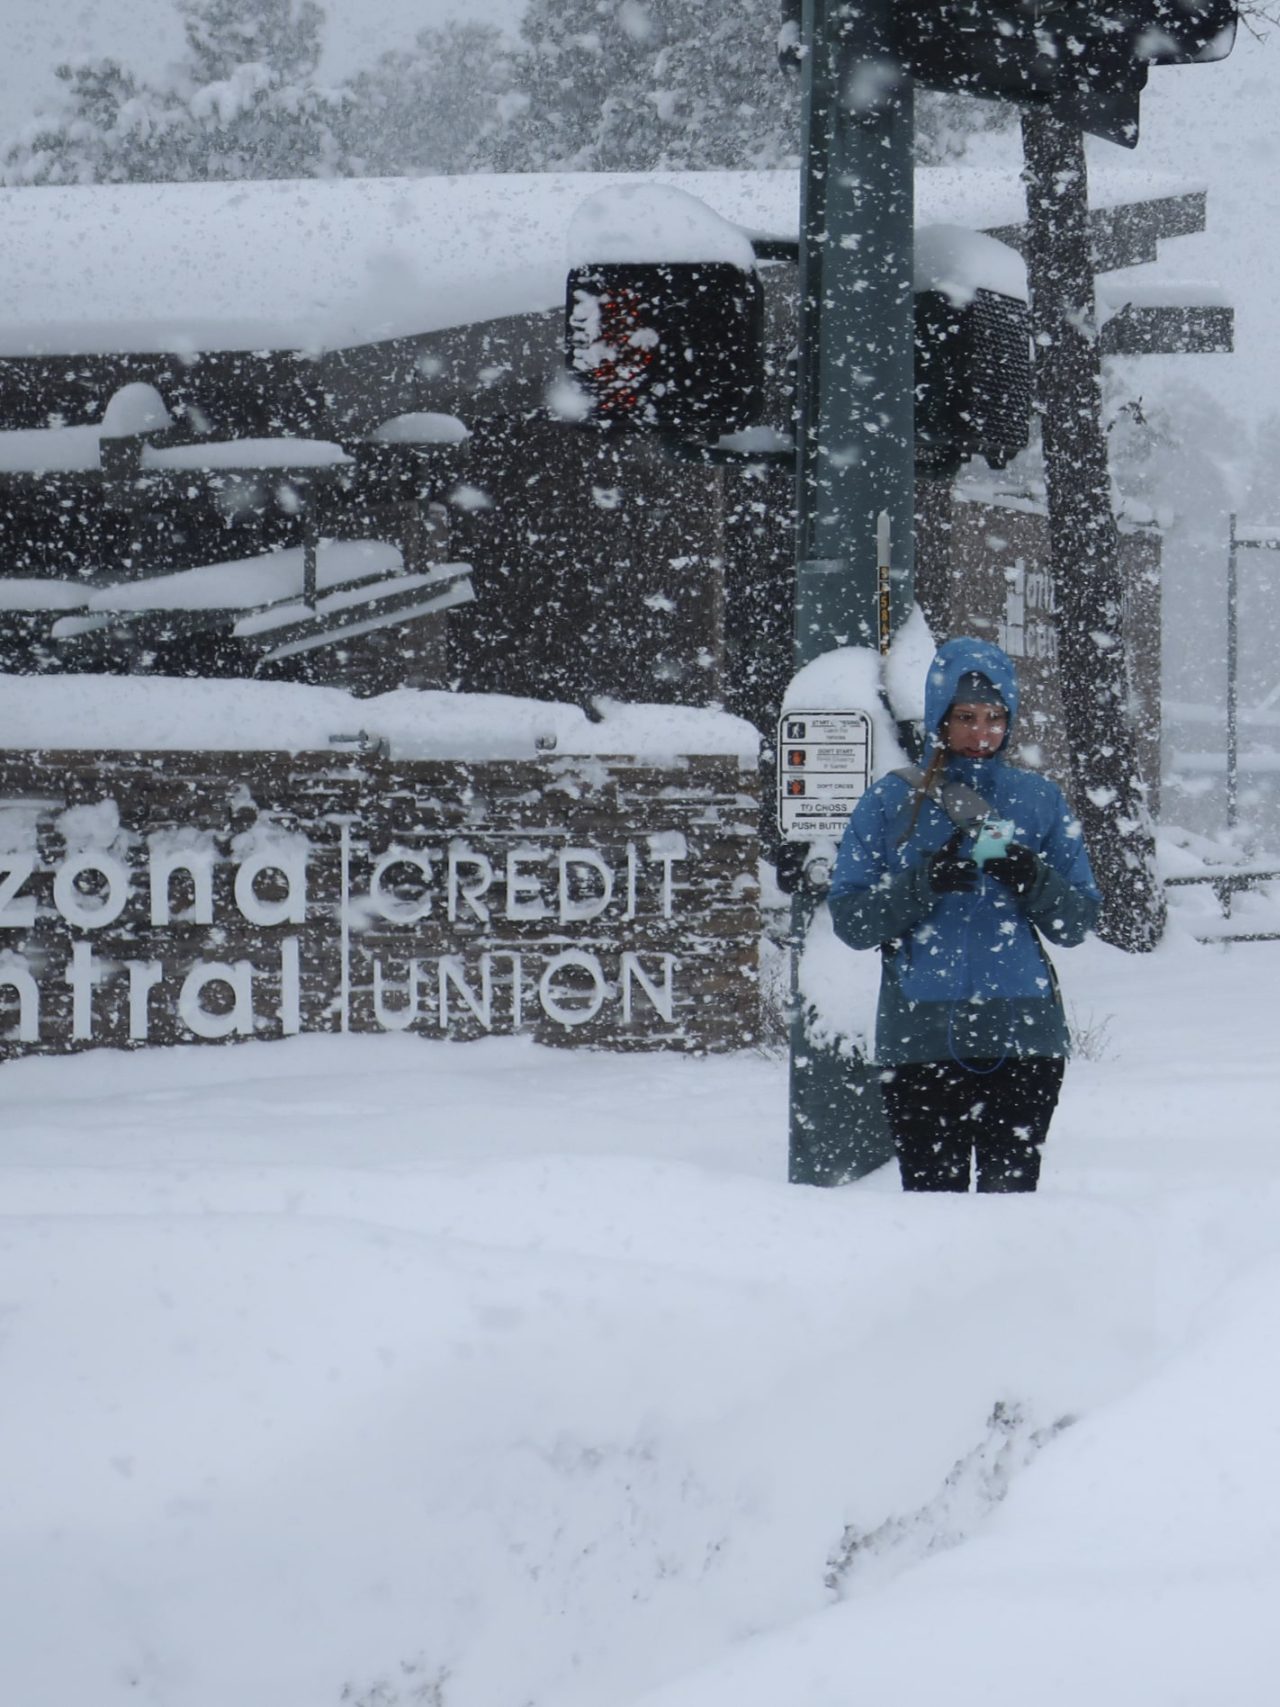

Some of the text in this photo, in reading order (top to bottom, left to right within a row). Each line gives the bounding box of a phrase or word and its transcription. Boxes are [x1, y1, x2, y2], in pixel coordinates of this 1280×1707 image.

[791, 821, 849, 830] PUSH BUTTO
[800, 803, 814, 811] TO
[370, 848, 685, 924] CREDIT
[373, 950, 674, 1031] UNION
